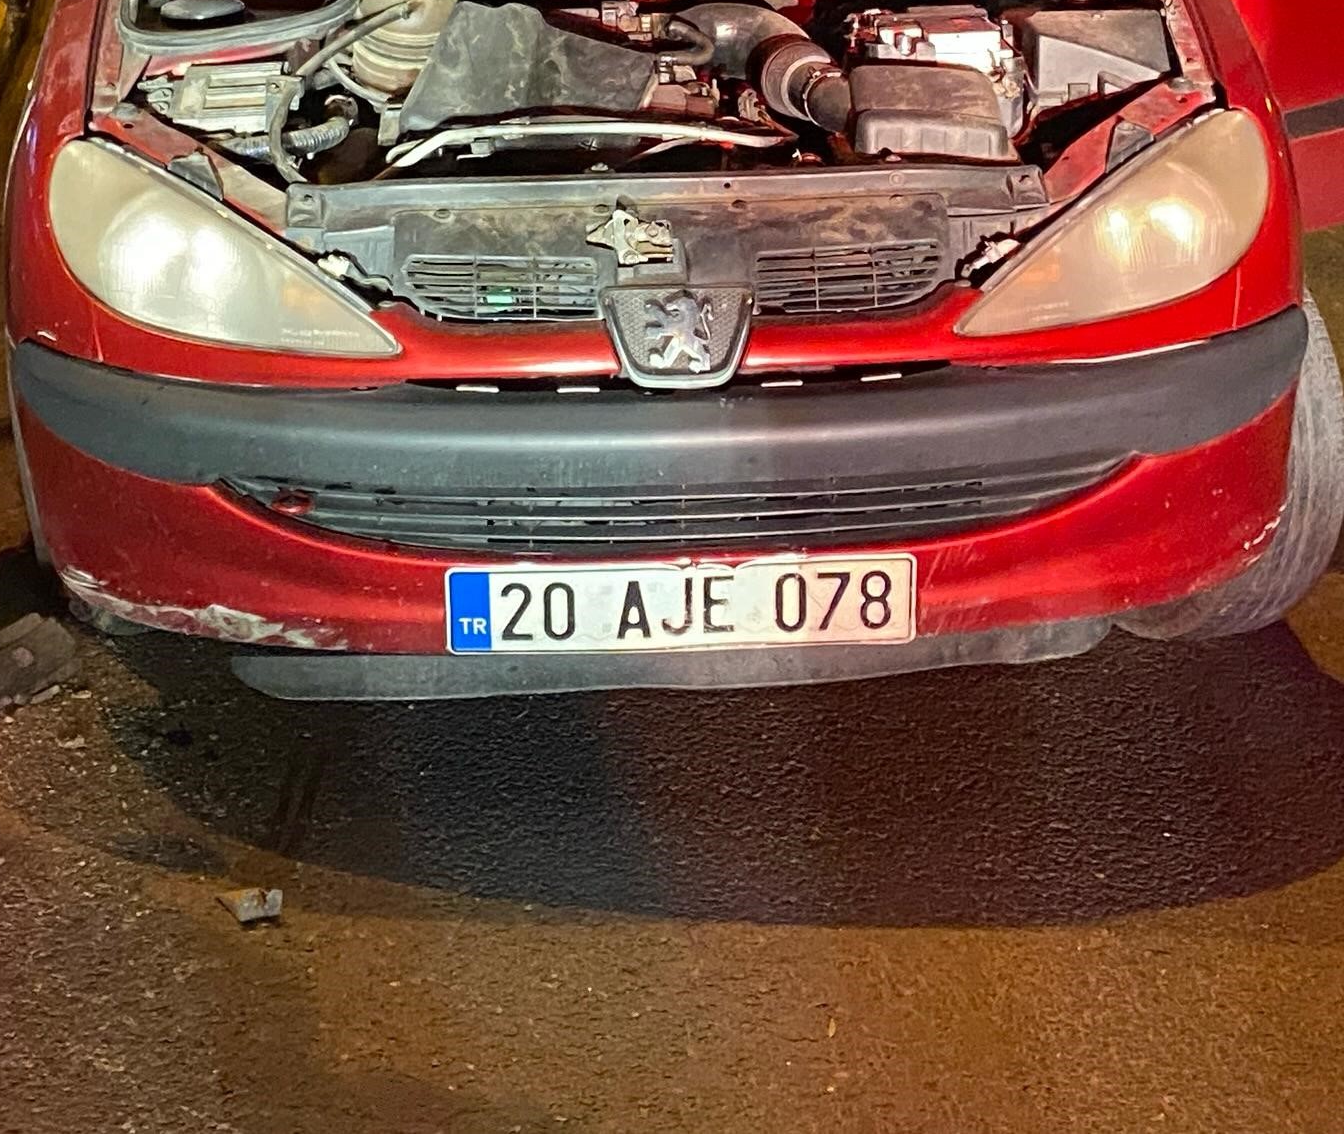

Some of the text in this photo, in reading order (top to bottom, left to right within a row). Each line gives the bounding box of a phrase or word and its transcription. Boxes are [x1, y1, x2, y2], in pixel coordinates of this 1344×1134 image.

[459, 617, 487, 635] TR
[500, 569, 893, 641] 20 AJE 078
